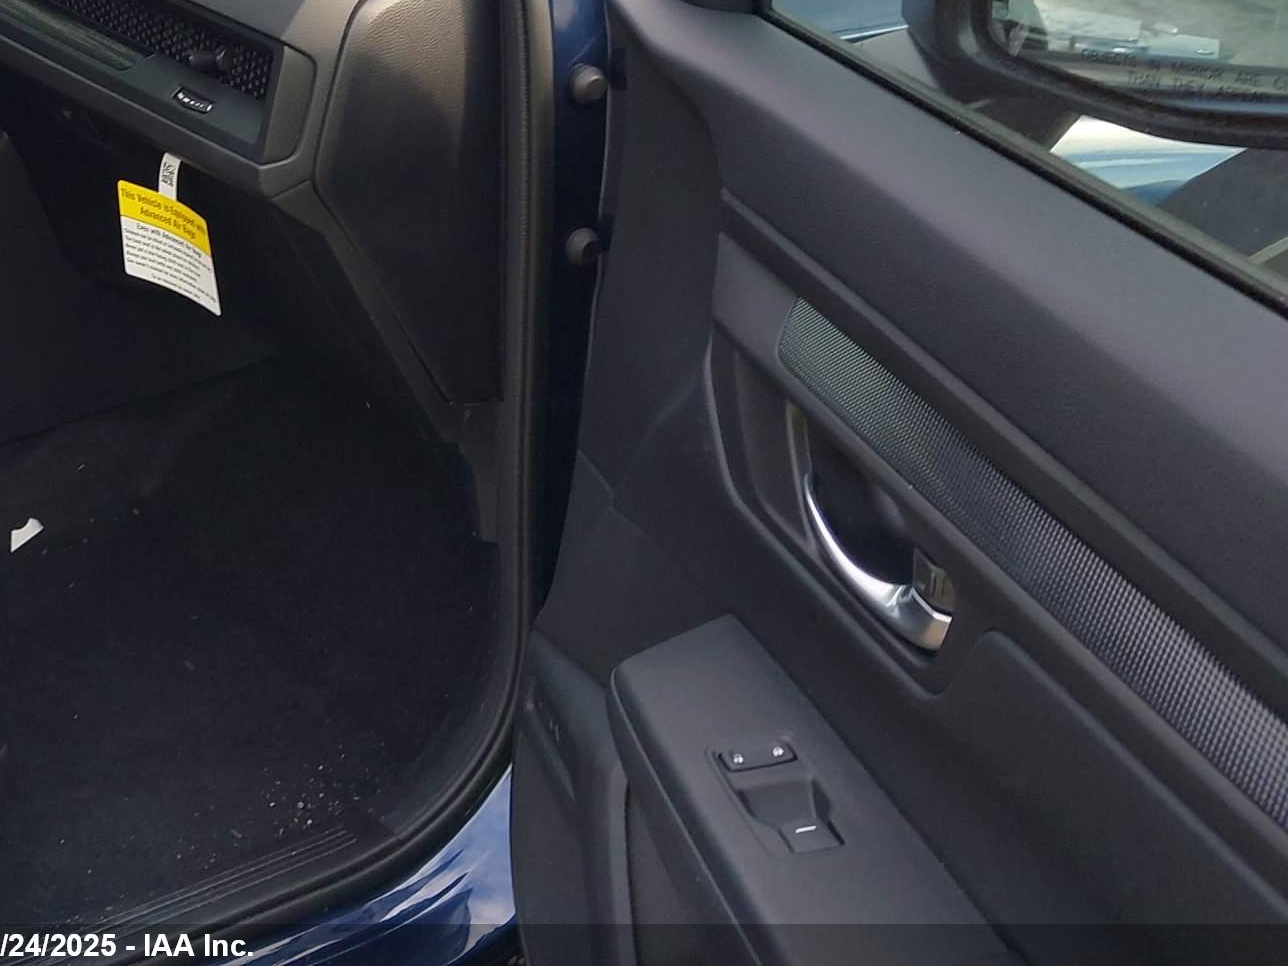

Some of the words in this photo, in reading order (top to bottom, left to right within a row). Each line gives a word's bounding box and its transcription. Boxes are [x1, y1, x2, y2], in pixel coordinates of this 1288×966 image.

[1128, 71, 1161, 89] THAN
[1173, 75, 1205, 93] THEY
[1171, 61, 1222, 80] MIRROR
[1234, 70, 1264, 87] ARE
[121, 188, 136, 201] This
